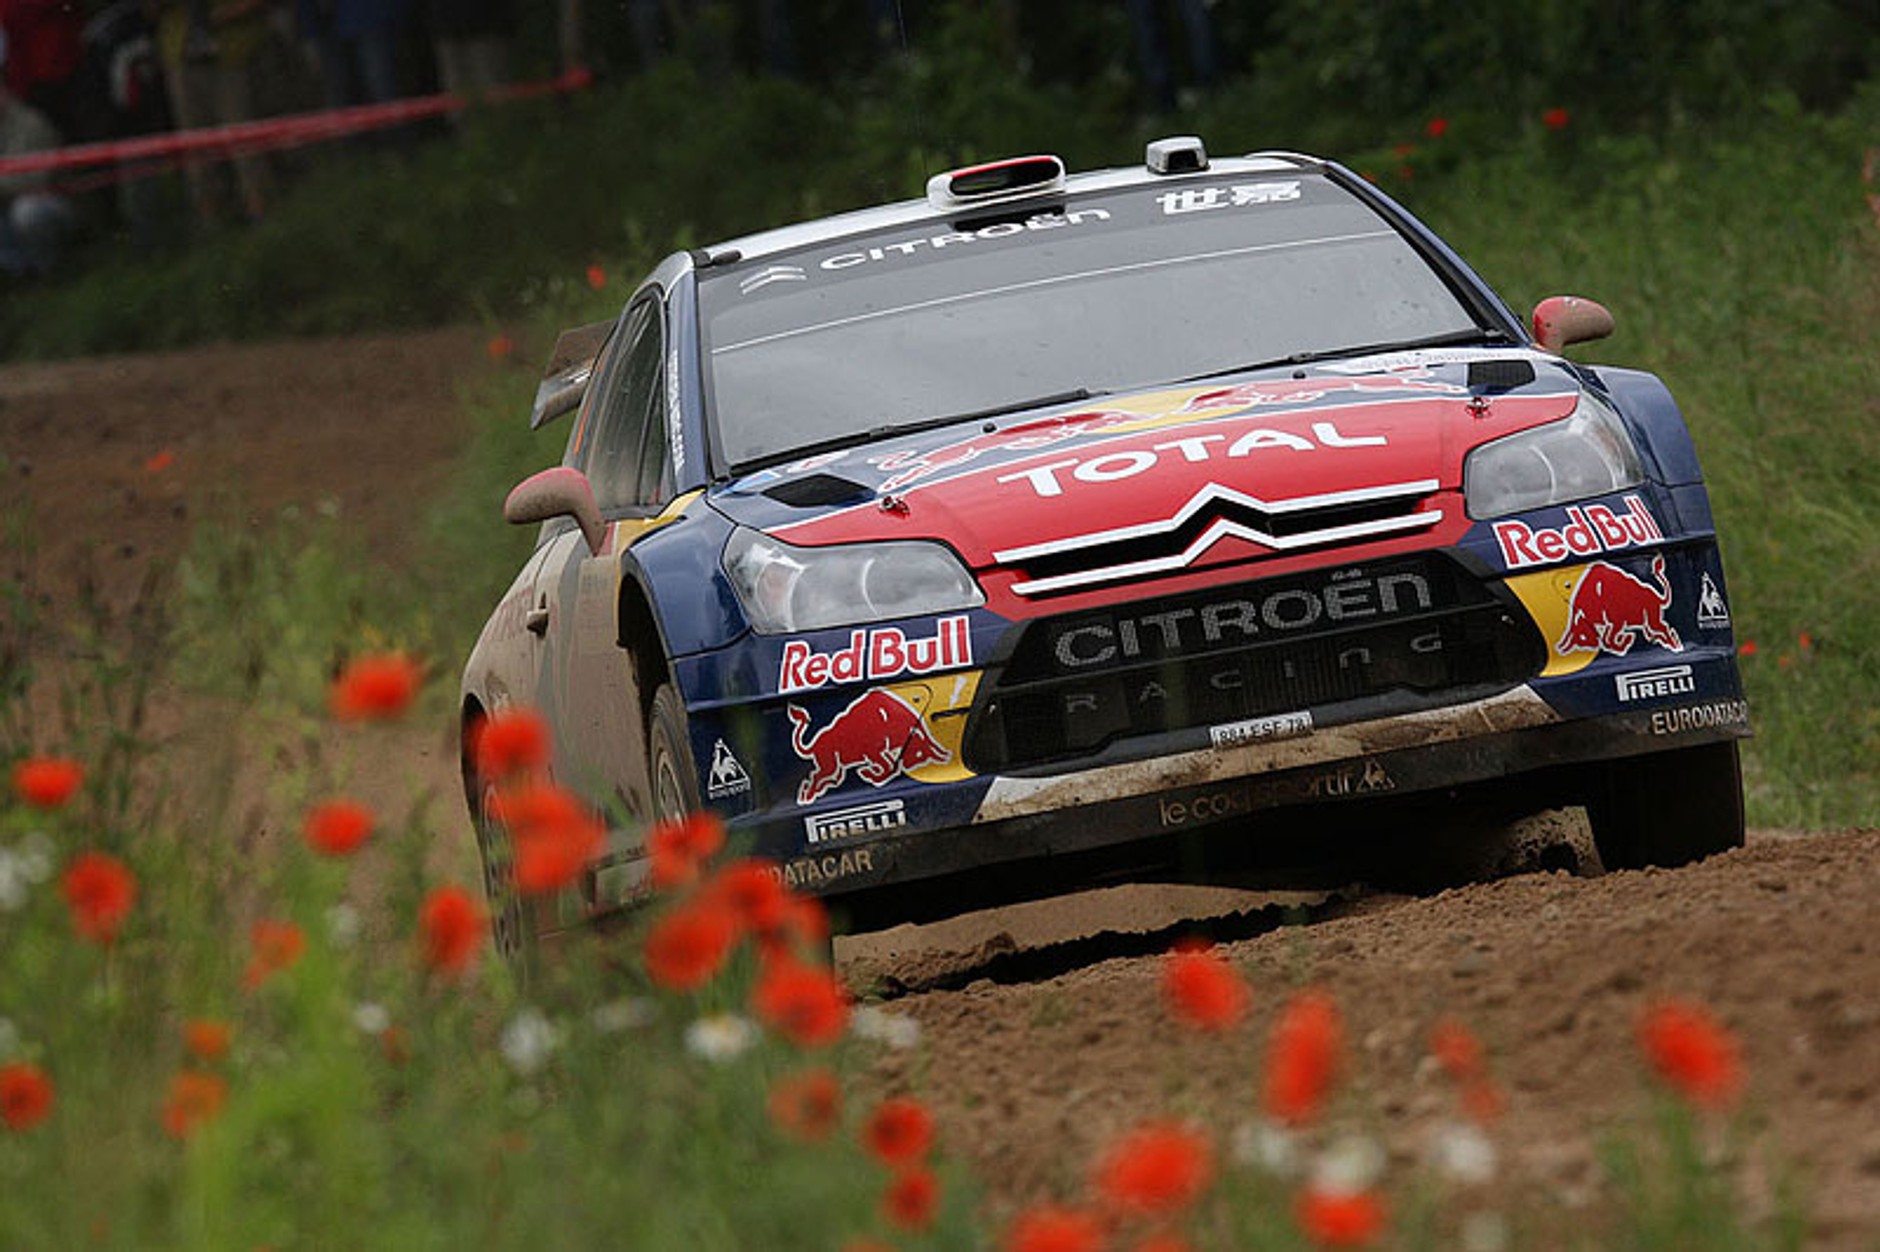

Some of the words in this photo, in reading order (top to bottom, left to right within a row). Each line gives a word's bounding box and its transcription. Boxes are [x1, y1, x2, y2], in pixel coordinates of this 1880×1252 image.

[997, 422, 1388, 497] TOTAL
[1614, 664, 1696, 702] PIRELLI
[804, 799, 907, 843] PIRELLI
